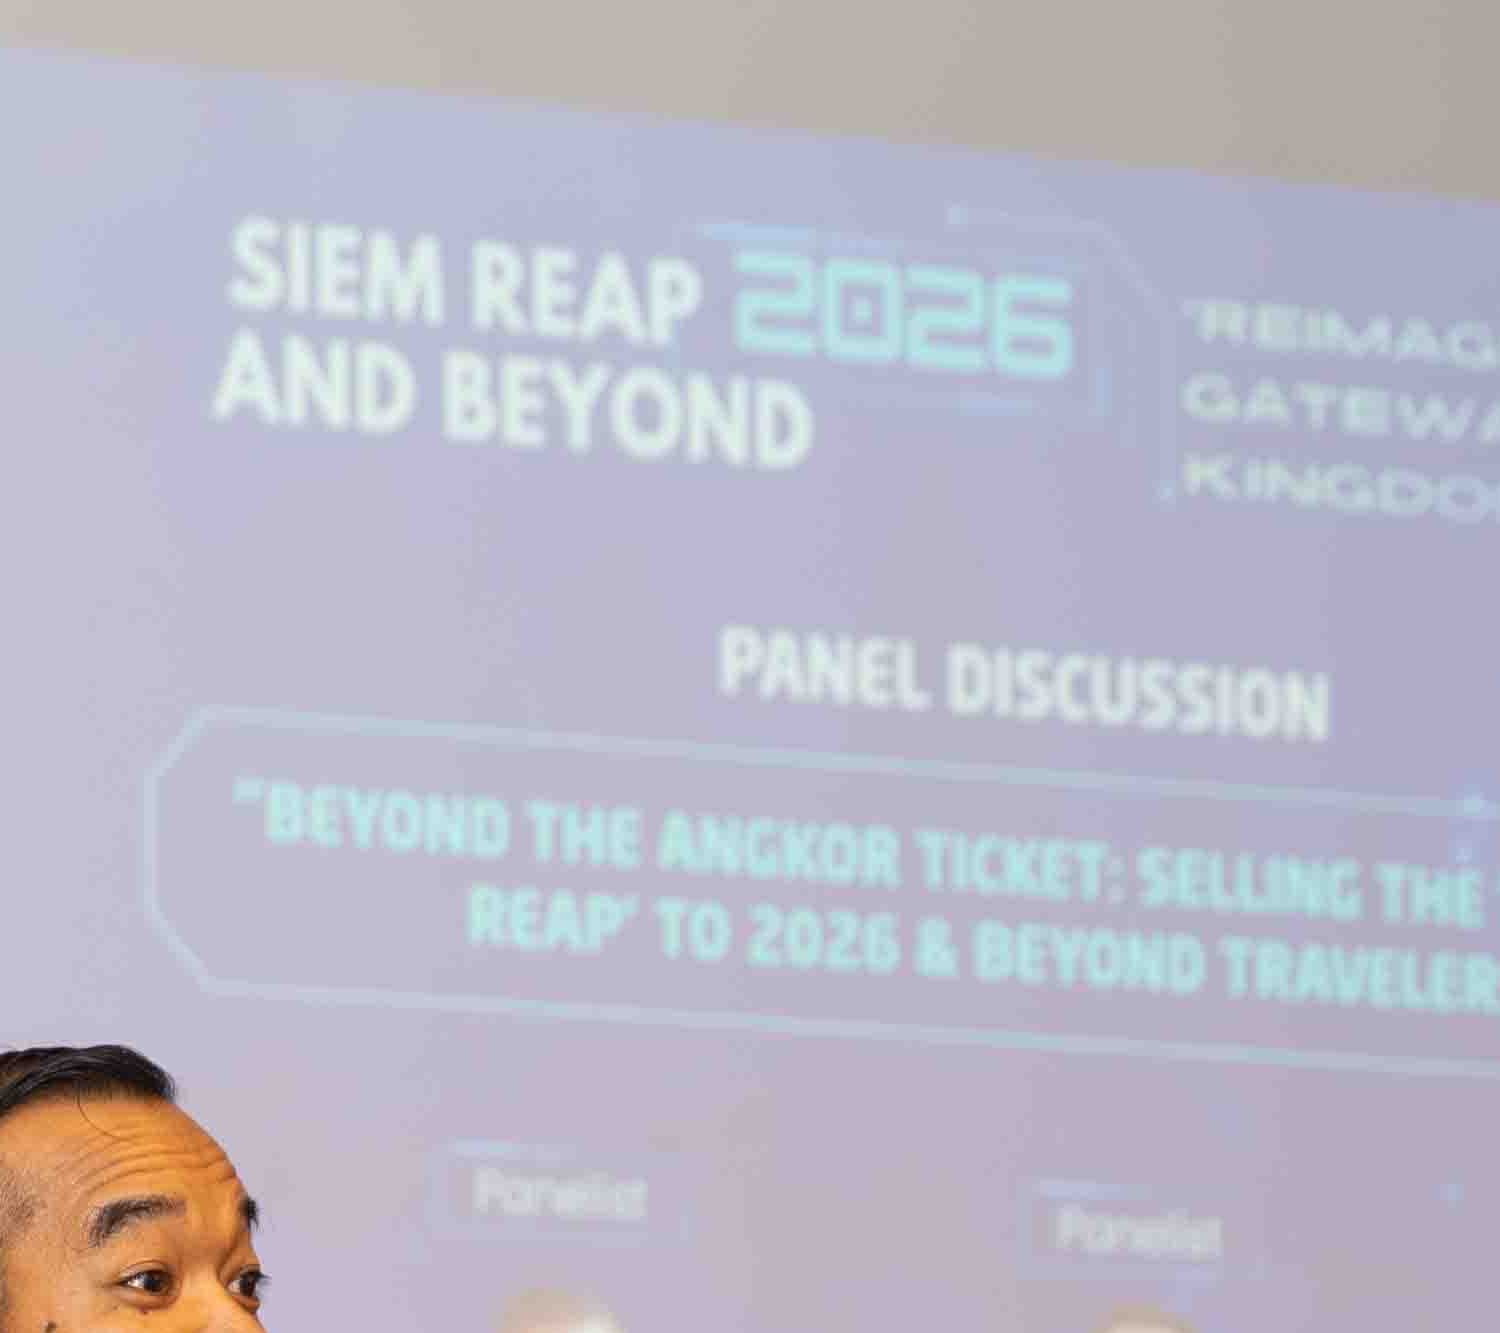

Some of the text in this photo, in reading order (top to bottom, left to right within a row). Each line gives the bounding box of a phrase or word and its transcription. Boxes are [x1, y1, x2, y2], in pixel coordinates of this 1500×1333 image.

[228, 215, 702, 346] SIEM REAP
[734, 252, 1074, 379] 2026
[211, 328, 815, 468] AND BEYOND
[720, 624, 1331, 741] PANEL DISCUSSION
[528, 799, 643, 871] THE
[658, 809, 903, 888] ANGKOR
[913, 829, 1125, 903] TICKET:
[1134, 845, 1365, 921] SELLING
[1376, 860, 1484, 930] THE
[655, 894, 732, 963] TO
[746, 901, 901, 972] 2026
[913, 915, 960, 977] &
[968, 917, 1207, 994] BEYOND
[470, 1168, 647, 1221] Panelist
[1055, 1203, 1223, 1262] Panelist
